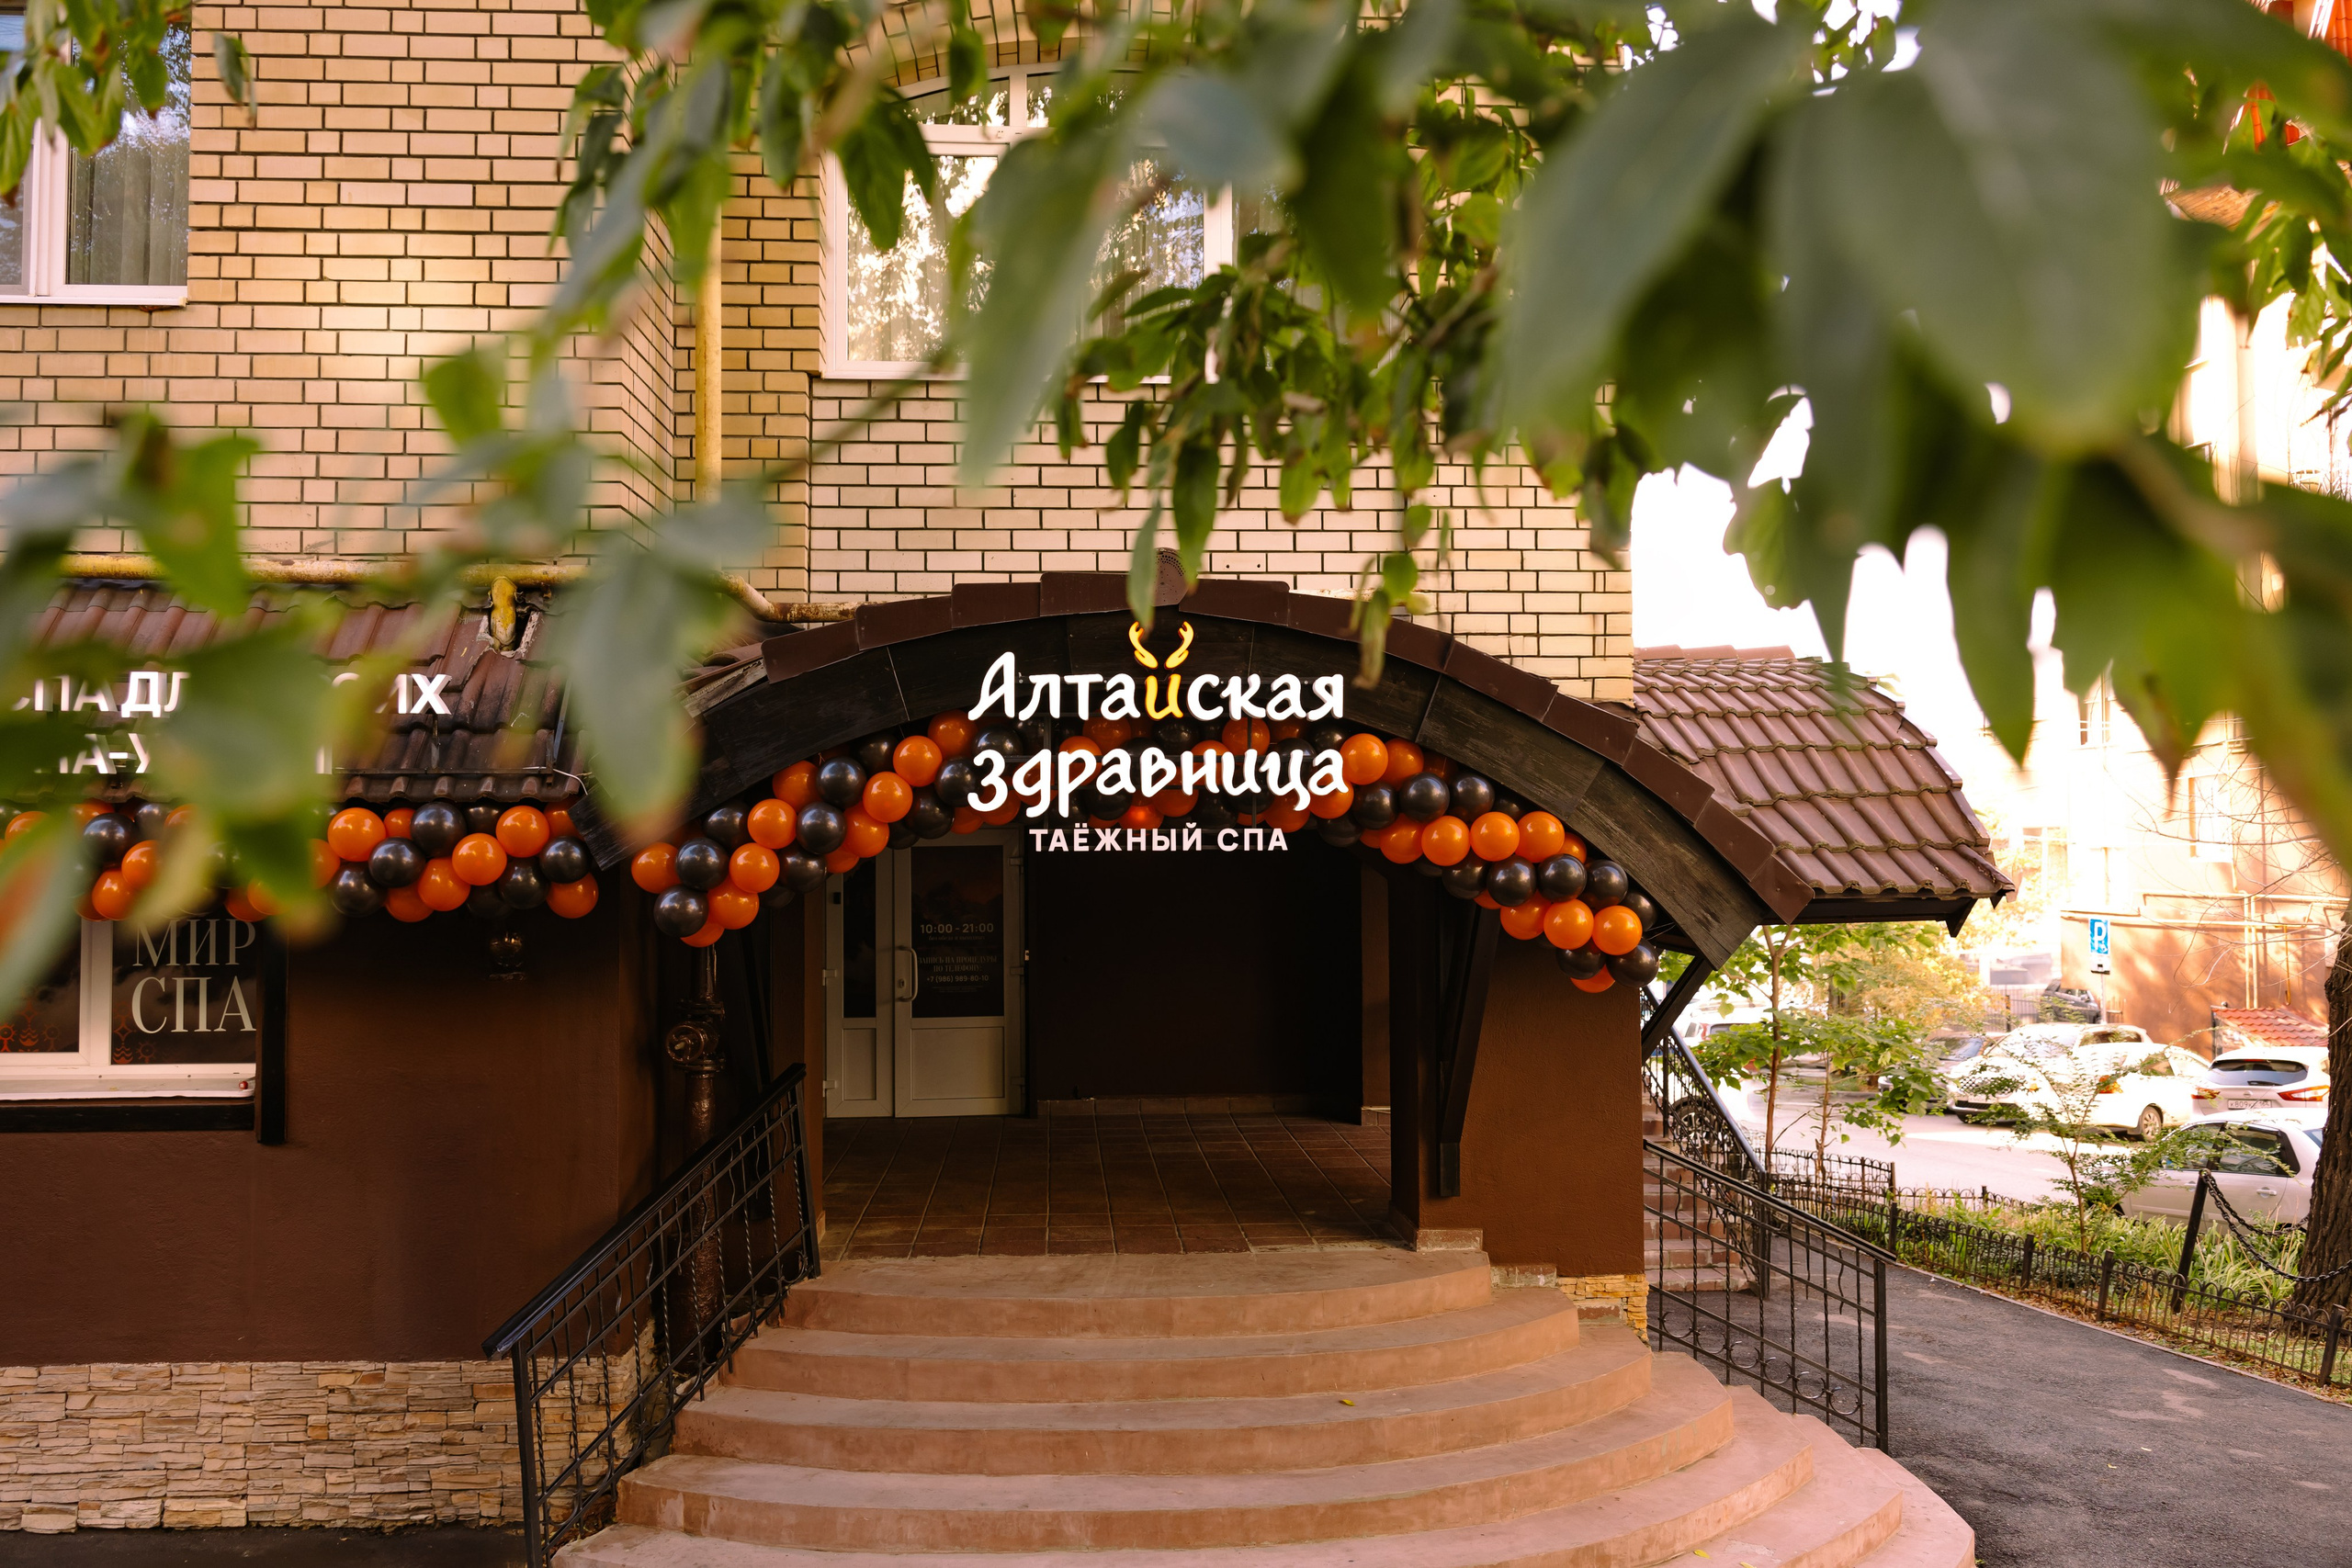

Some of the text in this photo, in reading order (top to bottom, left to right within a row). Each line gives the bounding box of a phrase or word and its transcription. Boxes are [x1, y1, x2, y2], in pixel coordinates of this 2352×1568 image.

[12, 674, 108, 712] ПА
[967, 621, 1344, 721] Алтайская
[967, 746, 1350, 818] Здравница
[1029, 822, 1288, 852] ТАЁЖНЫЙ СПА
[132, 919, 256, 966] МИР
[920, 923, 953, 934] 10:00
[962, 922, 994, 933] 21:00
[131, 976, 256, 1034] СПА
